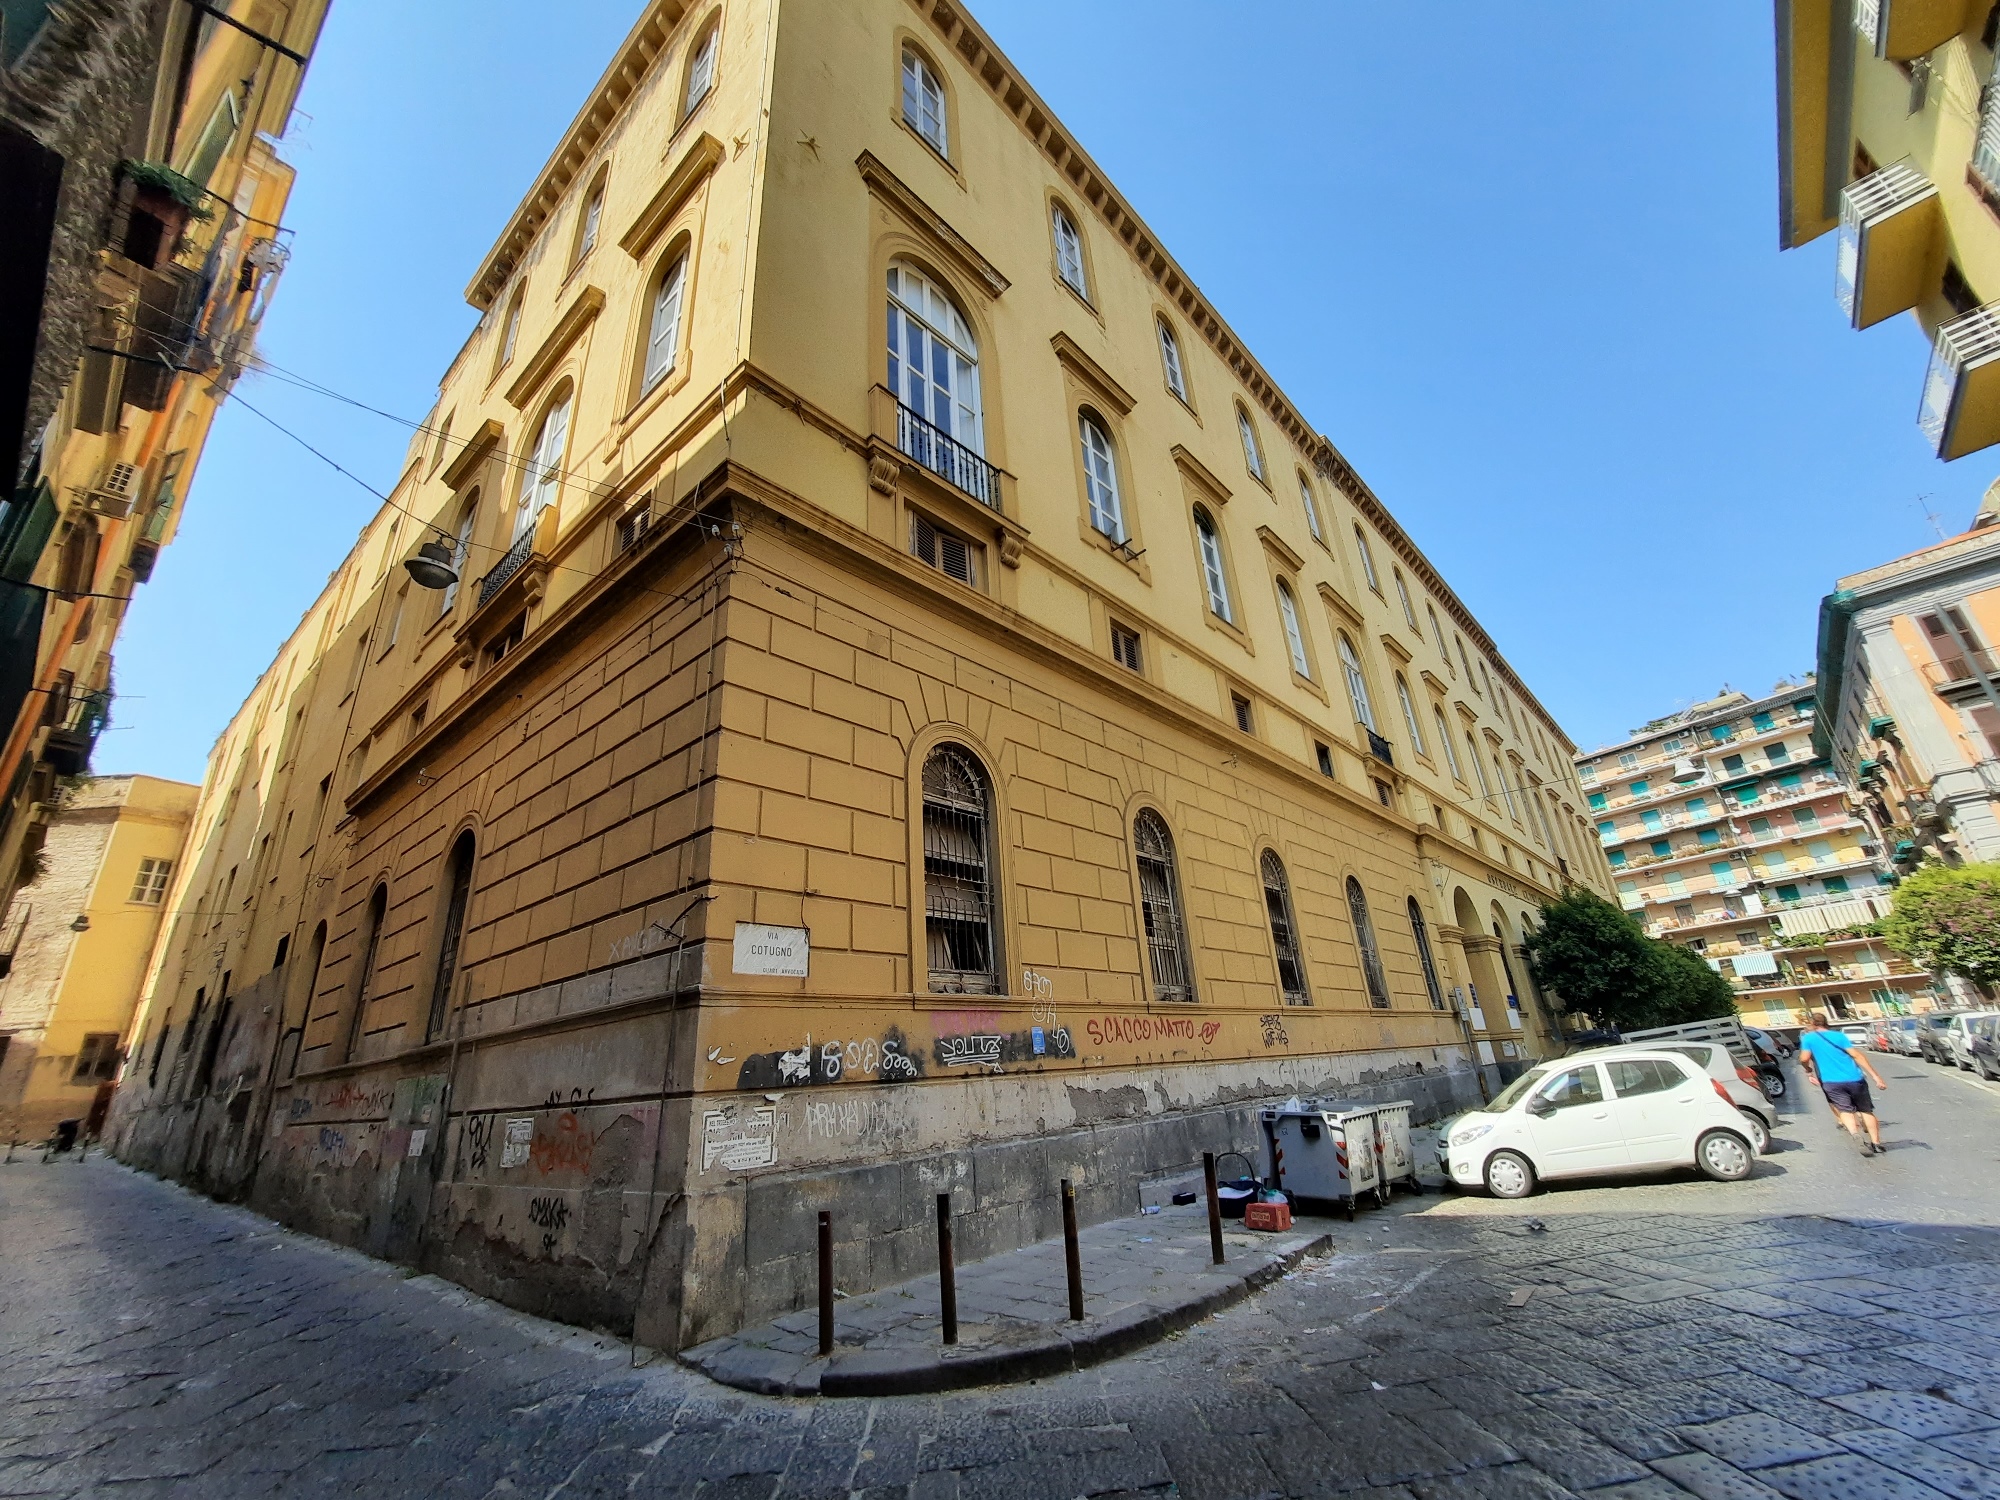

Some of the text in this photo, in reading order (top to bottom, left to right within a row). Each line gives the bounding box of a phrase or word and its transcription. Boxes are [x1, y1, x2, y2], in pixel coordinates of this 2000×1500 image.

[767, 931, 779, 940] VIA
[751, 944, 792, 957] COTUGNO
[1086, 1017, 1195, 1045] SCACCO MATTO
